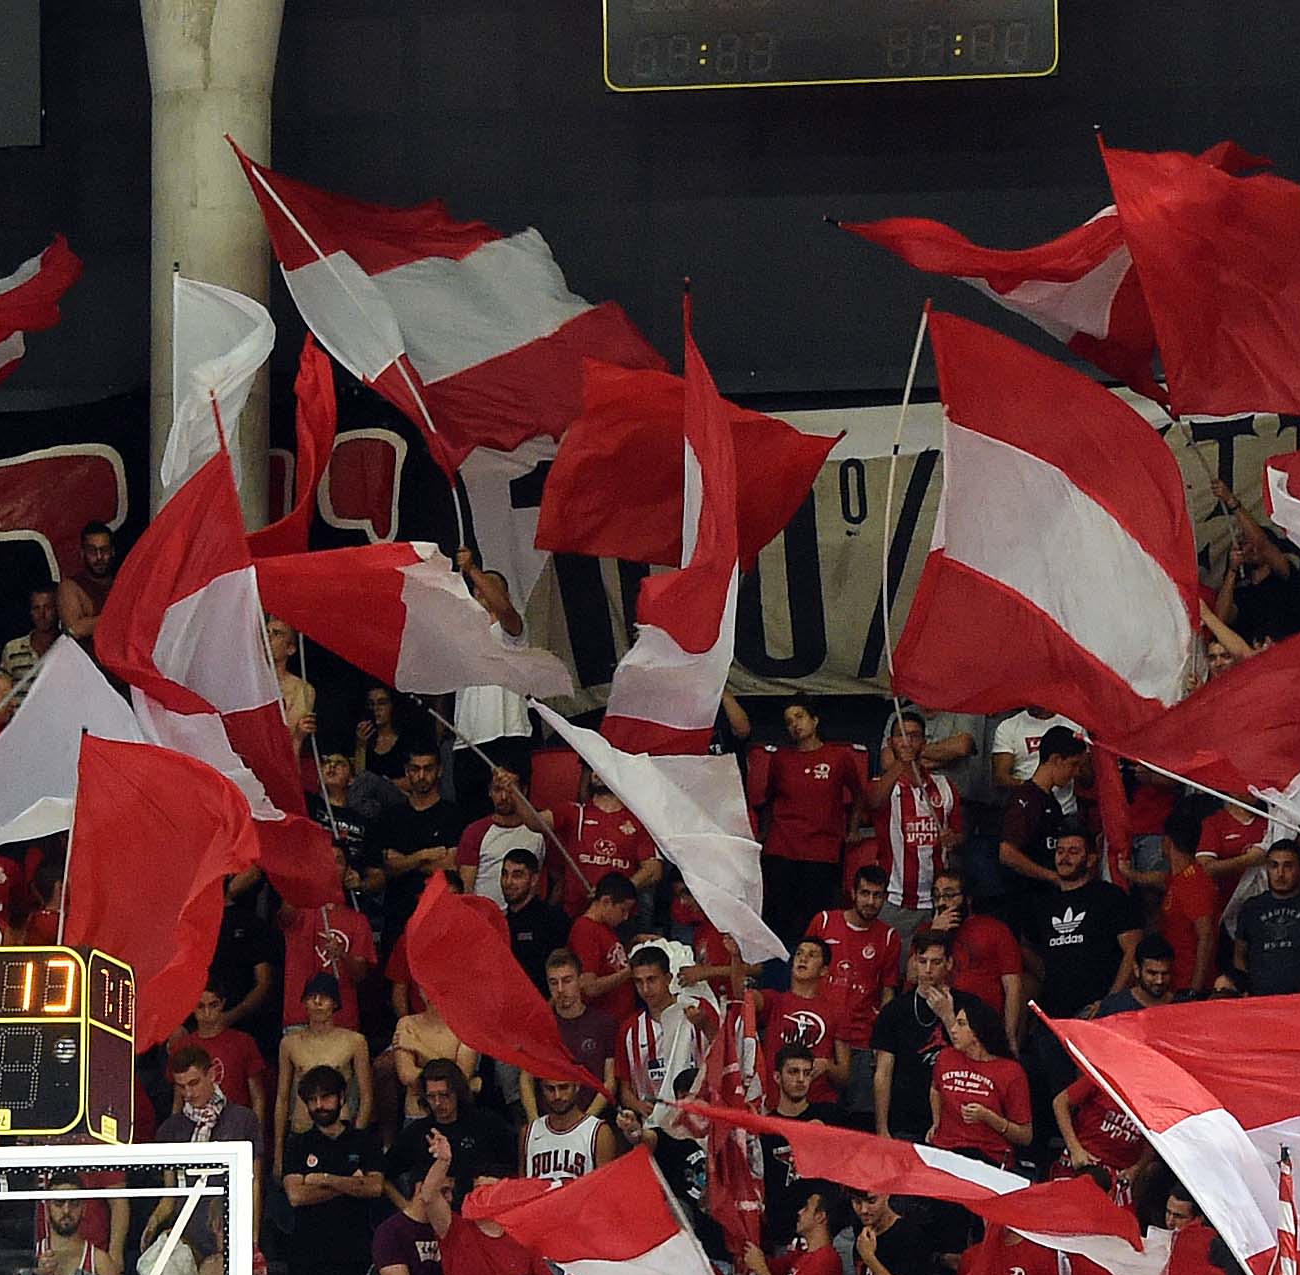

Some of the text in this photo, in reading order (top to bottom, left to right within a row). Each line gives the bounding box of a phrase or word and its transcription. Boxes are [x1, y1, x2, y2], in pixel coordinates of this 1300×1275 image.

[578, 853, 630, 870] SUBARU
[1048, 934, 1084, 947] adidas
[531, 1148, 586, 1178] BULLS
